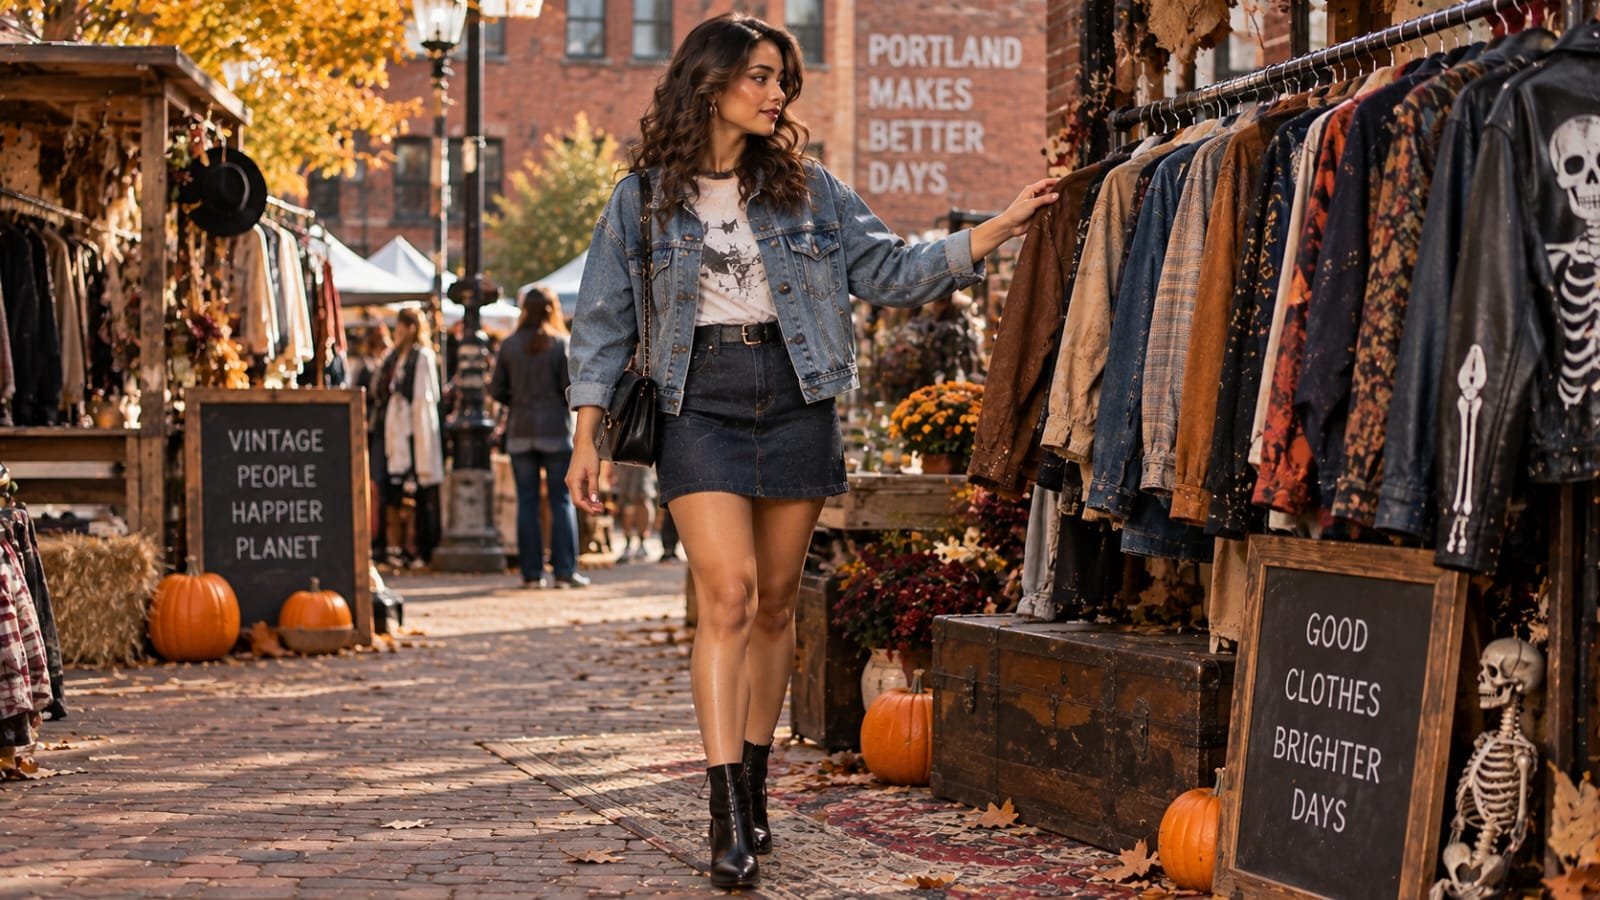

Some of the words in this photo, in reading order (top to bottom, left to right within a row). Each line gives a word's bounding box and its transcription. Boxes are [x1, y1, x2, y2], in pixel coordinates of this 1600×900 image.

[868, 33, 1023, 69] PORTLAND
[868, 76, 974, 111] MAKES
[868, 119, 985, 153] BETTER
[868, 160, 949, 194] DAYS
[228, 429, 324, 452] VINTAGE
[237, 464, 317, 488] PEOPLE
[231, 500, 323, 524] HAPPIER
[236, 535, 321, 560] PLANET
[1306, 612, 1368, 652] GOOD
[1285, 668, 1381, 717] CLOTHES
[1273, 726, 1382, 784] BRIGHTER
[1291, 788, 1347, 833] DAYS
